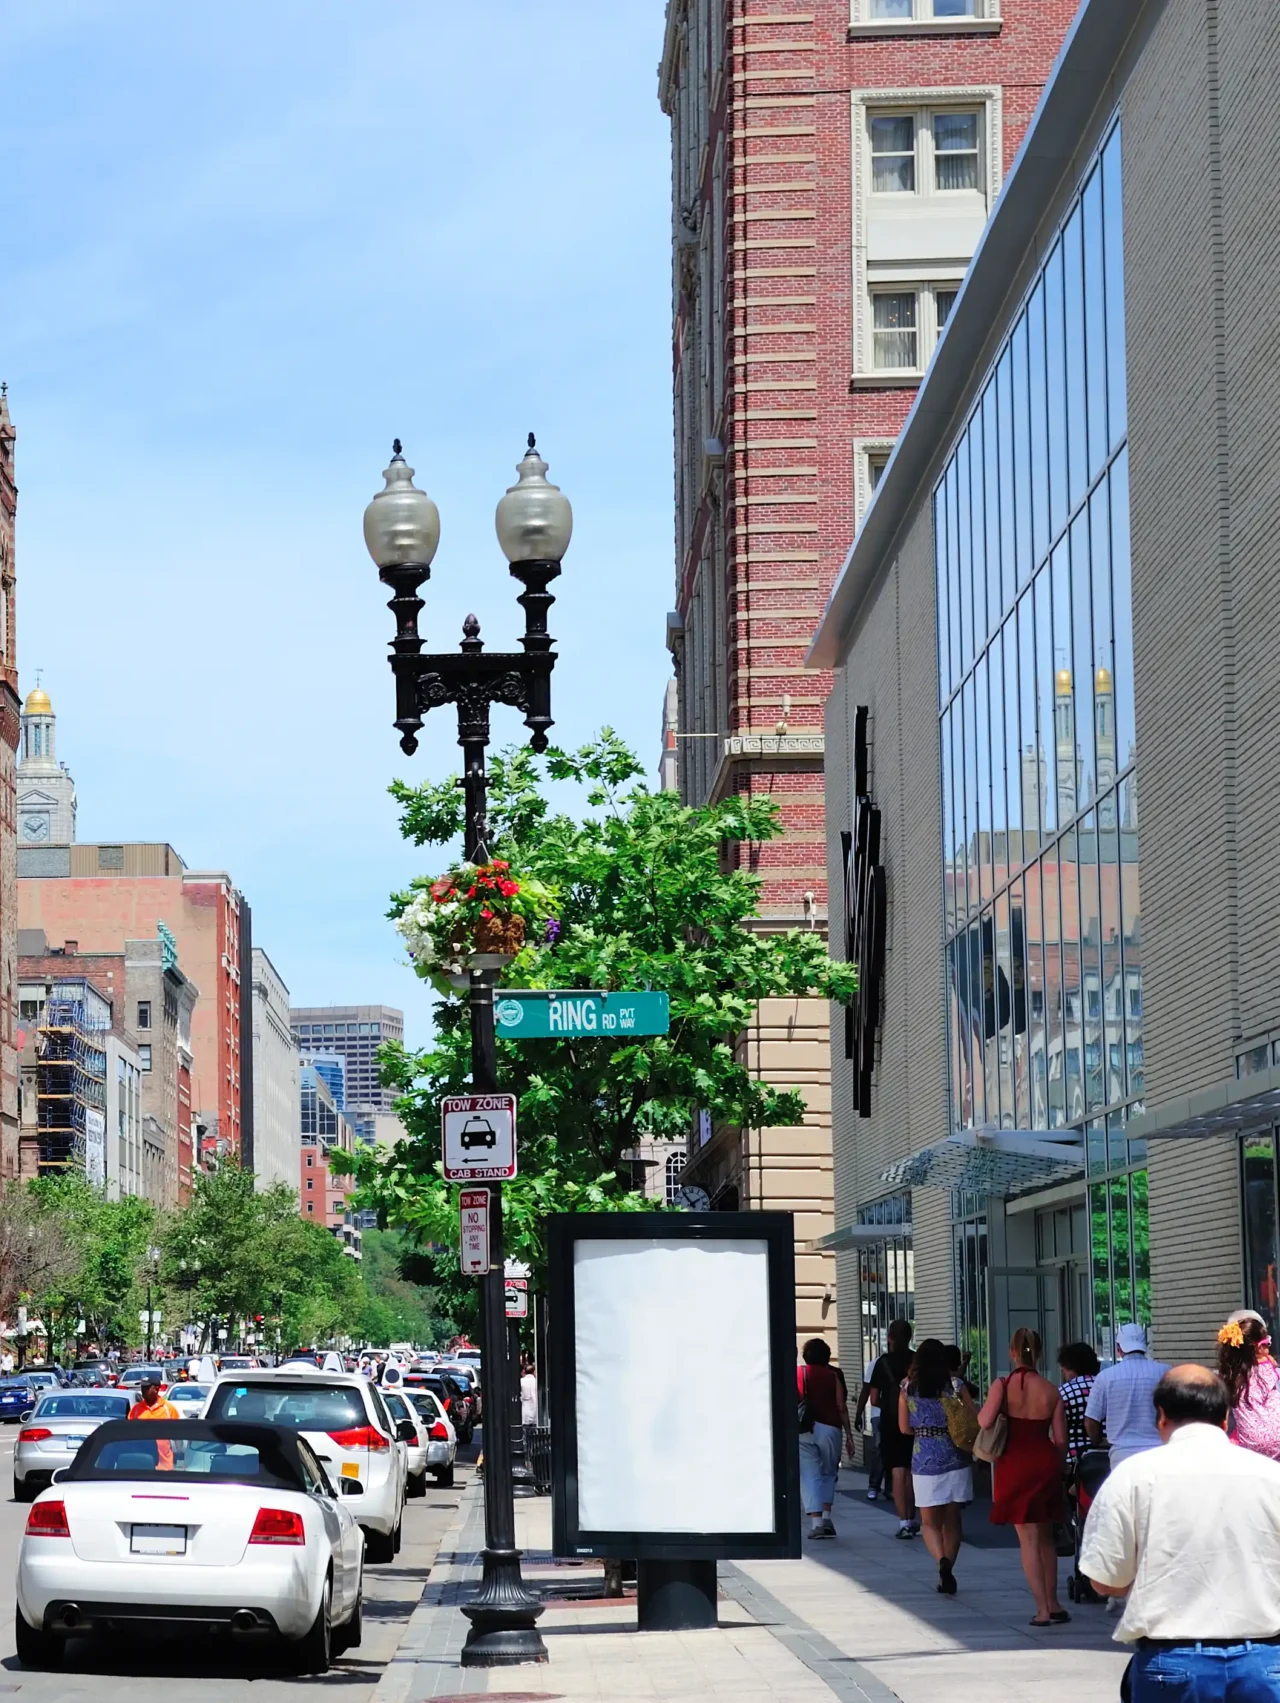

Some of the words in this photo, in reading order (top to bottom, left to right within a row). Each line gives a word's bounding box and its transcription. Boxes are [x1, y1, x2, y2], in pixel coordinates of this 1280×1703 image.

[549, 999, 597, 1031] RING
[602, 1013, 617, 1029] RD
[619, 1008, 635, 1018] PVT
[619, 1018, 635, 1028] WAY
[446, 1099, 471, 1111] TOW
[475, 1097, 510, 1110] ZONE
[449, 1169, 471, 1179] CAB
[475, 1167, 509, 1178] STAND
[461, 1196, 471, 1206] TOW
[472, 1195, 487, 1205] ZONE
[468, 1212, 479, 1223] NO
[463, 1225, 485, 1233] STOPPING
